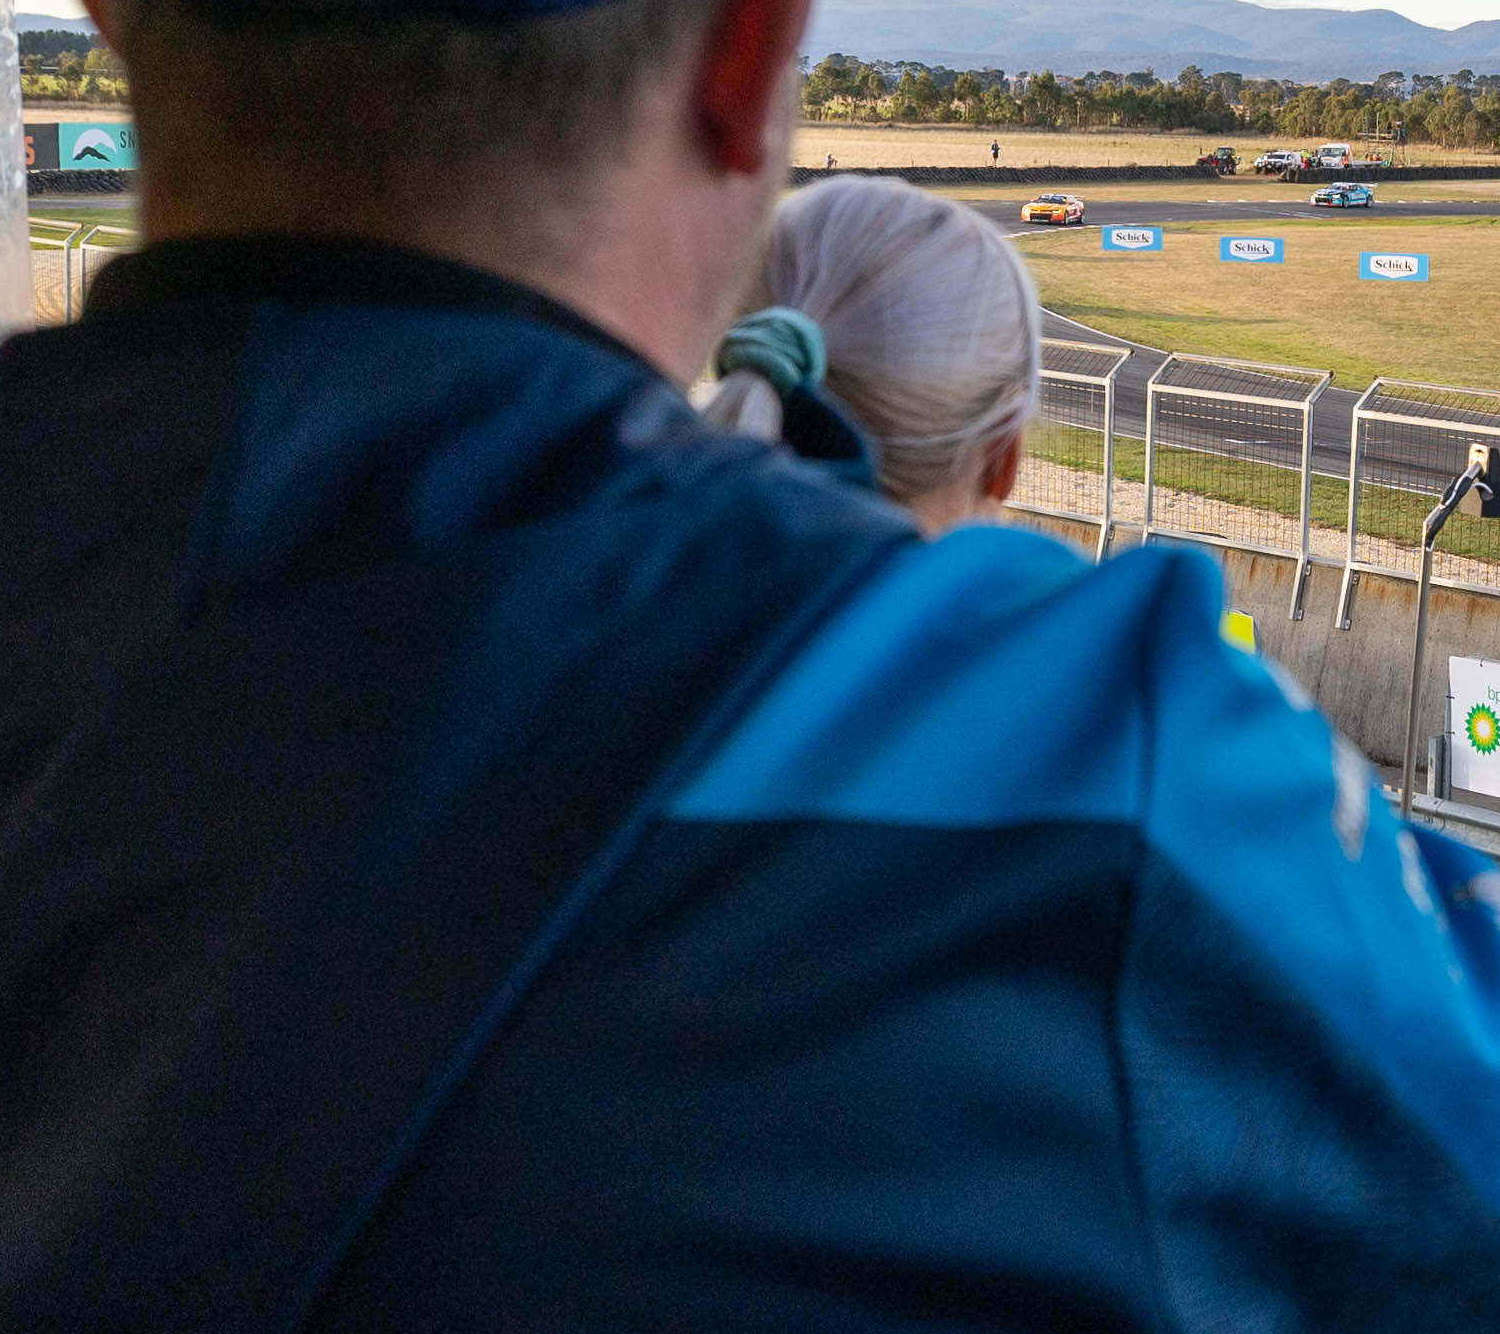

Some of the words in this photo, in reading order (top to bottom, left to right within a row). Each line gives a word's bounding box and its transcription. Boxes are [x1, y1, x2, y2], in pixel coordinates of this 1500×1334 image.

[1115, 231, 1150, 244] Schick
[1234, 243, 1270, 255] Schick
[1374, 258, 1415, 272] Schick
